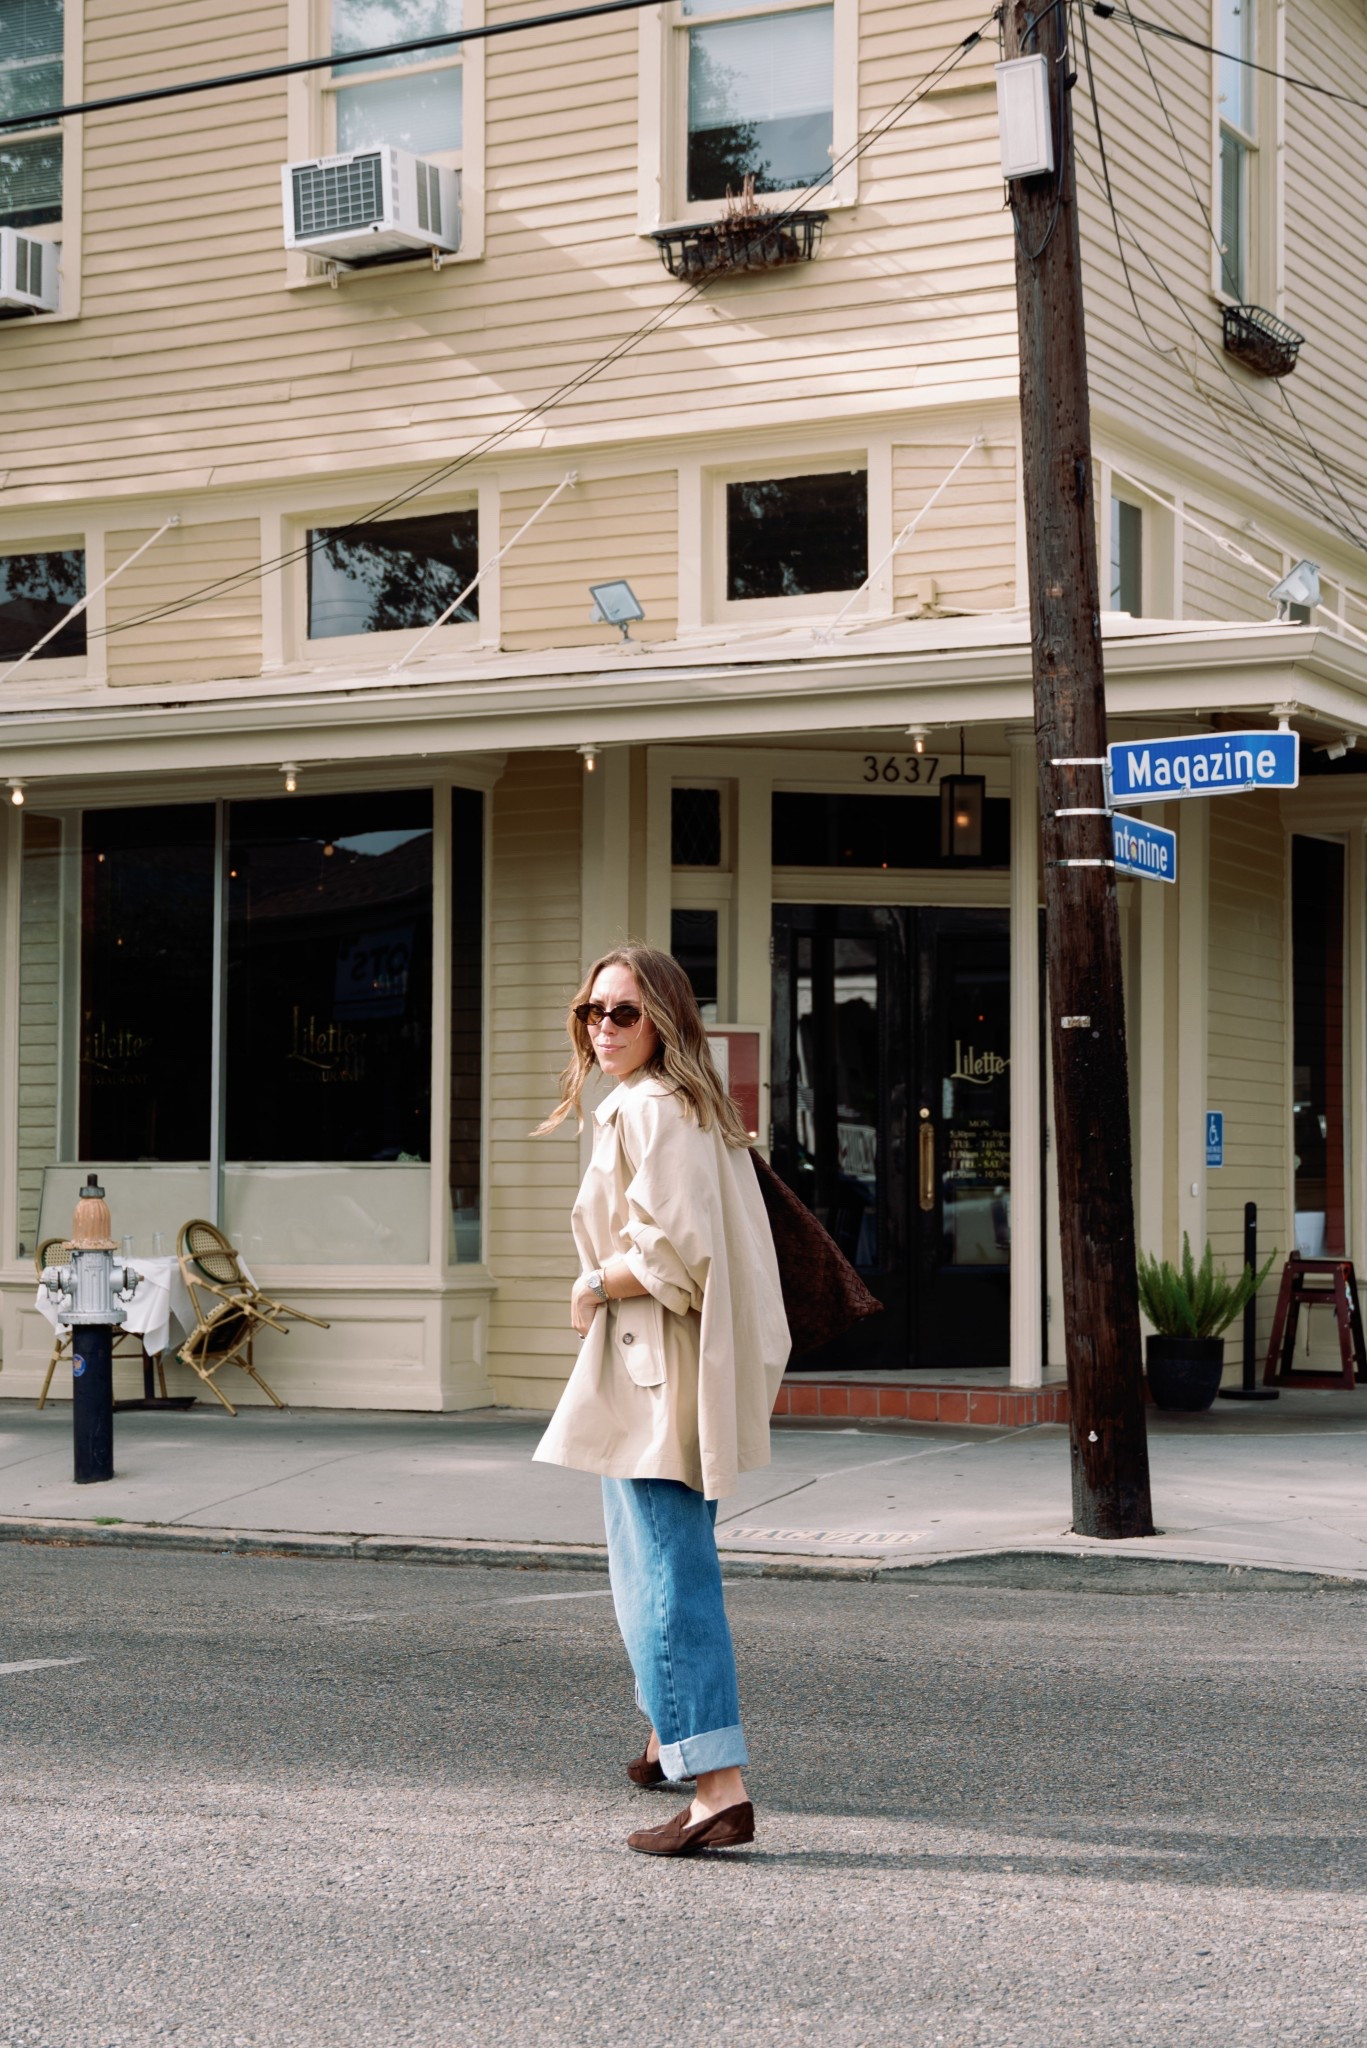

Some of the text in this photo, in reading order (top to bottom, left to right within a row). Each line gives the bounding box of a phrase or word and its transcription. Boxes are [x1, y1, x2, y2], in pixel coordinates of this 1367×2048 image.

[863, 755, 939, 784] 3637
[1127, 742, 1276, 789] Magazine
[1114, 825, 1168, 872] ntonine
[285, 1005, 367, 1069] Lilette
[82, 1073, 149, 1085] STAURANT
[951, 1039, 1010, 1084] Lilette
[985, 1170, 1010, 1180] 10:30p
[725, 1528, 926, 1544] MAGAZINE
